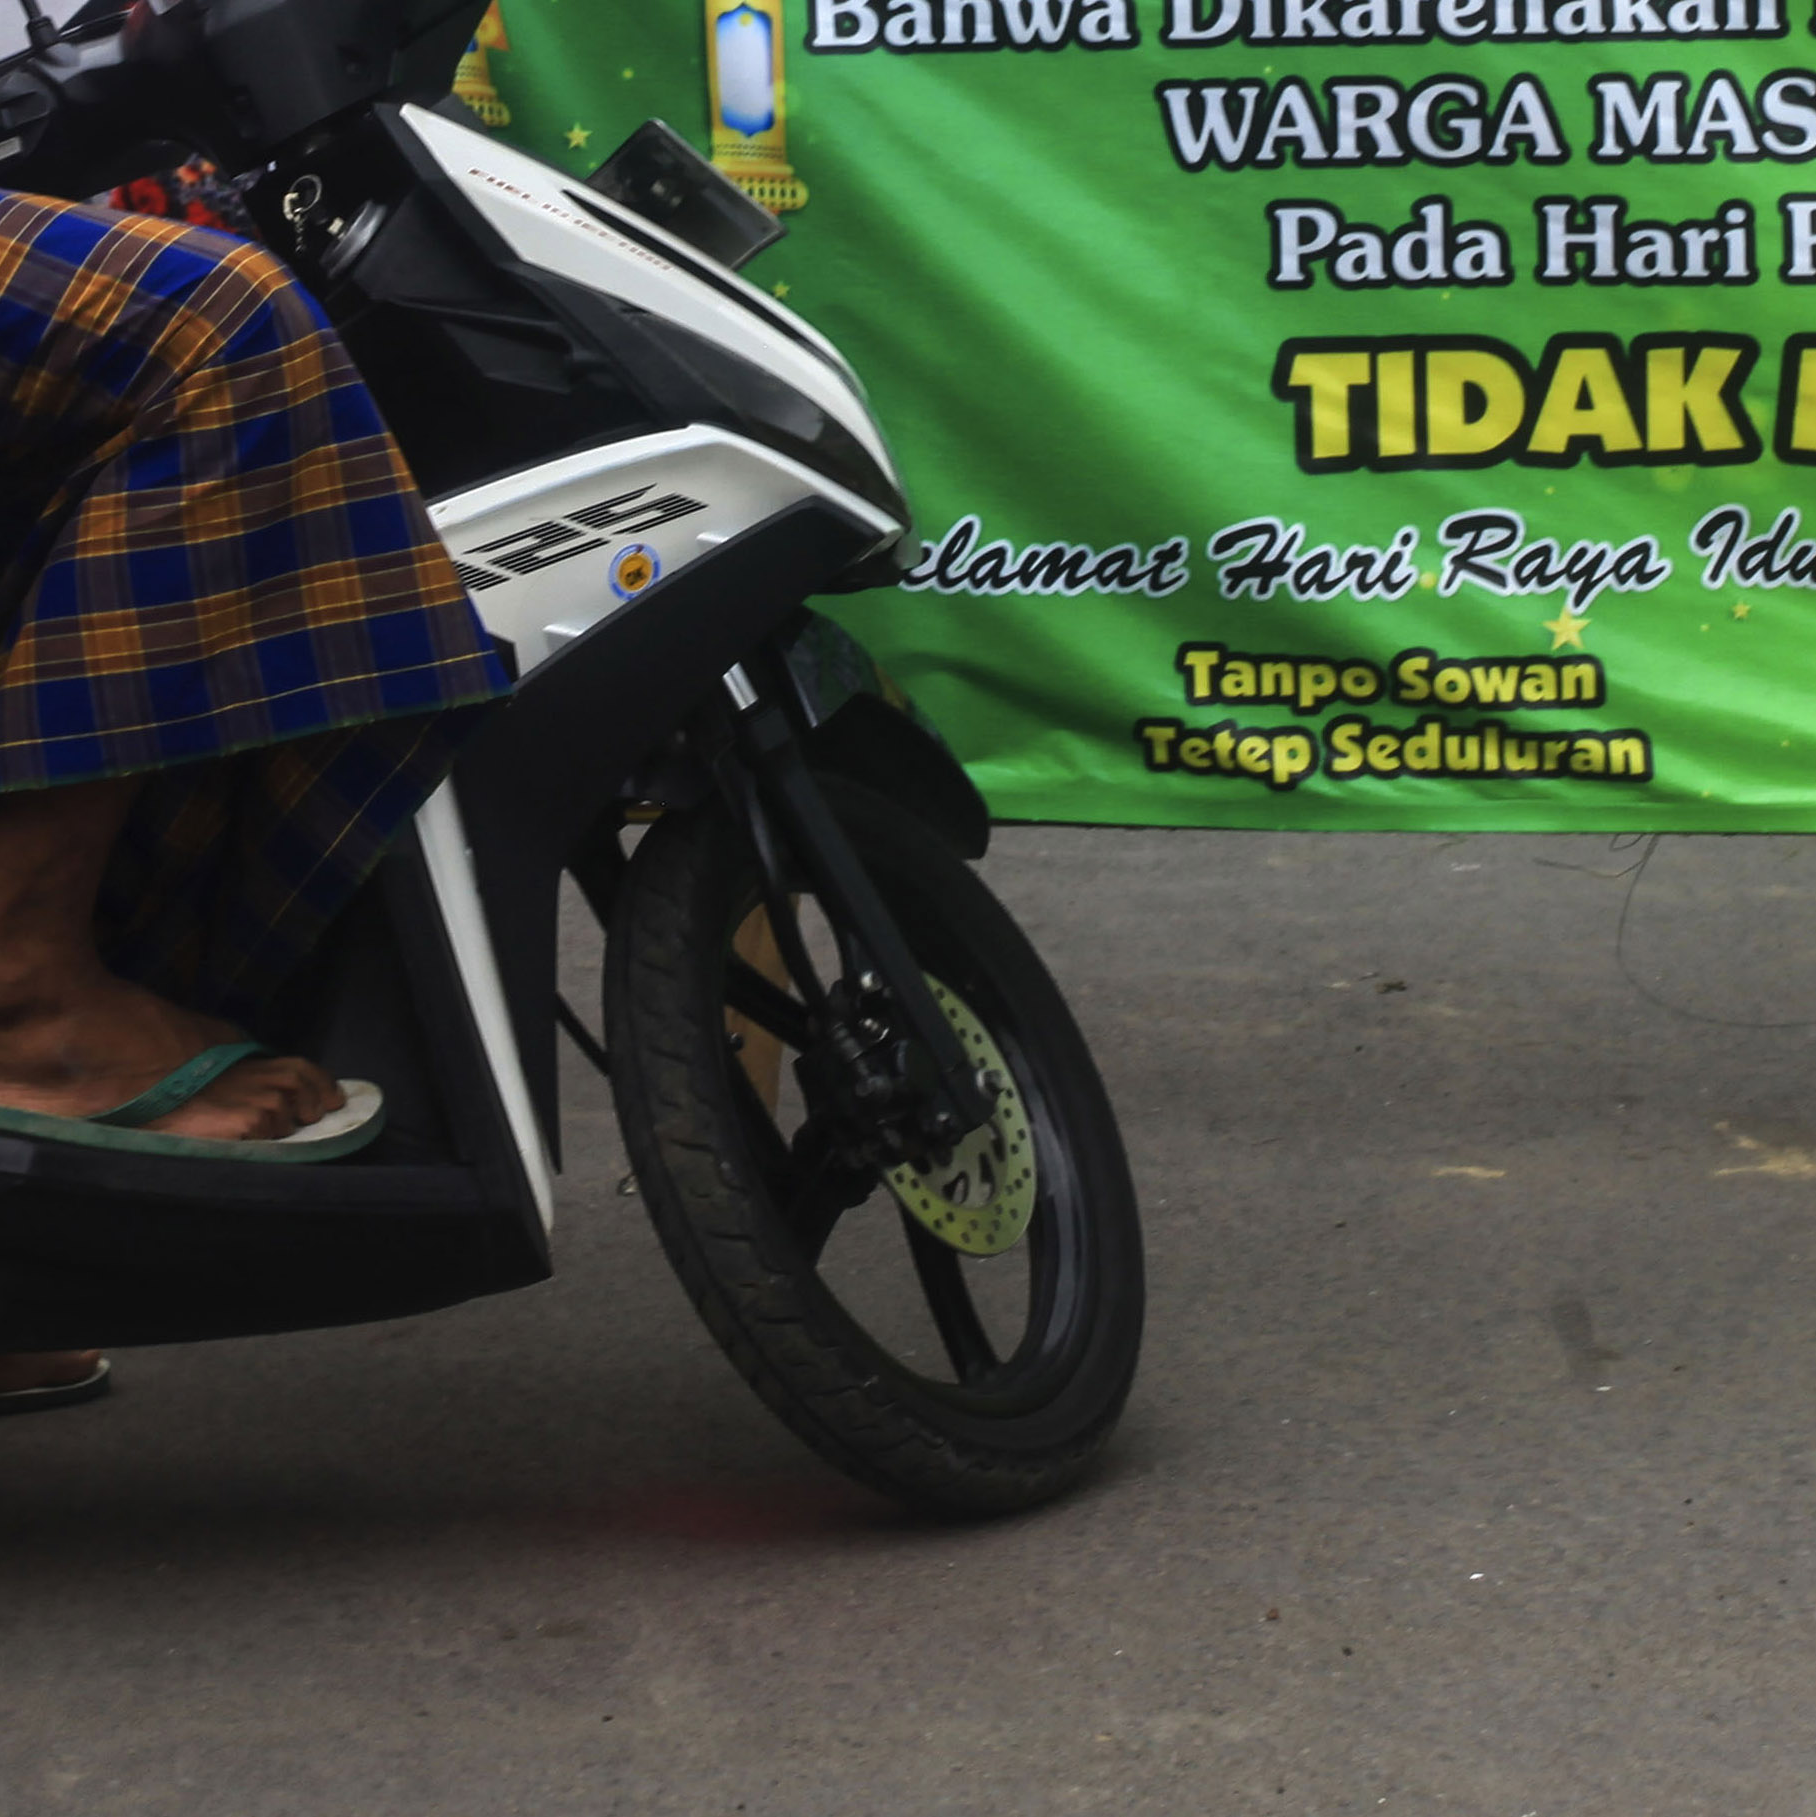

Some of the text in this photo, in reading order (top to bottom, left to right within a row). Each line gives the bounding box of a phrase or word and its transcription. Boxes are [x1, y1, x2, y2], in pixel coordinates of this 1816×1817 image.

[1158, 78, 1563, 168] WARGA
[1270, 200, 1509, 290] Pada
[1536, 200, 1750, 288] Hari
[1276, 334, 1761, 472] TIDAK
[1208, 515, 1419, 600] Hari
[1439, 509, 1671, 614] Raya
[1175, 642, 1606, 714] Tanpo Sowan
[1135, 716, 1655, 789] Tetep Seduluran
